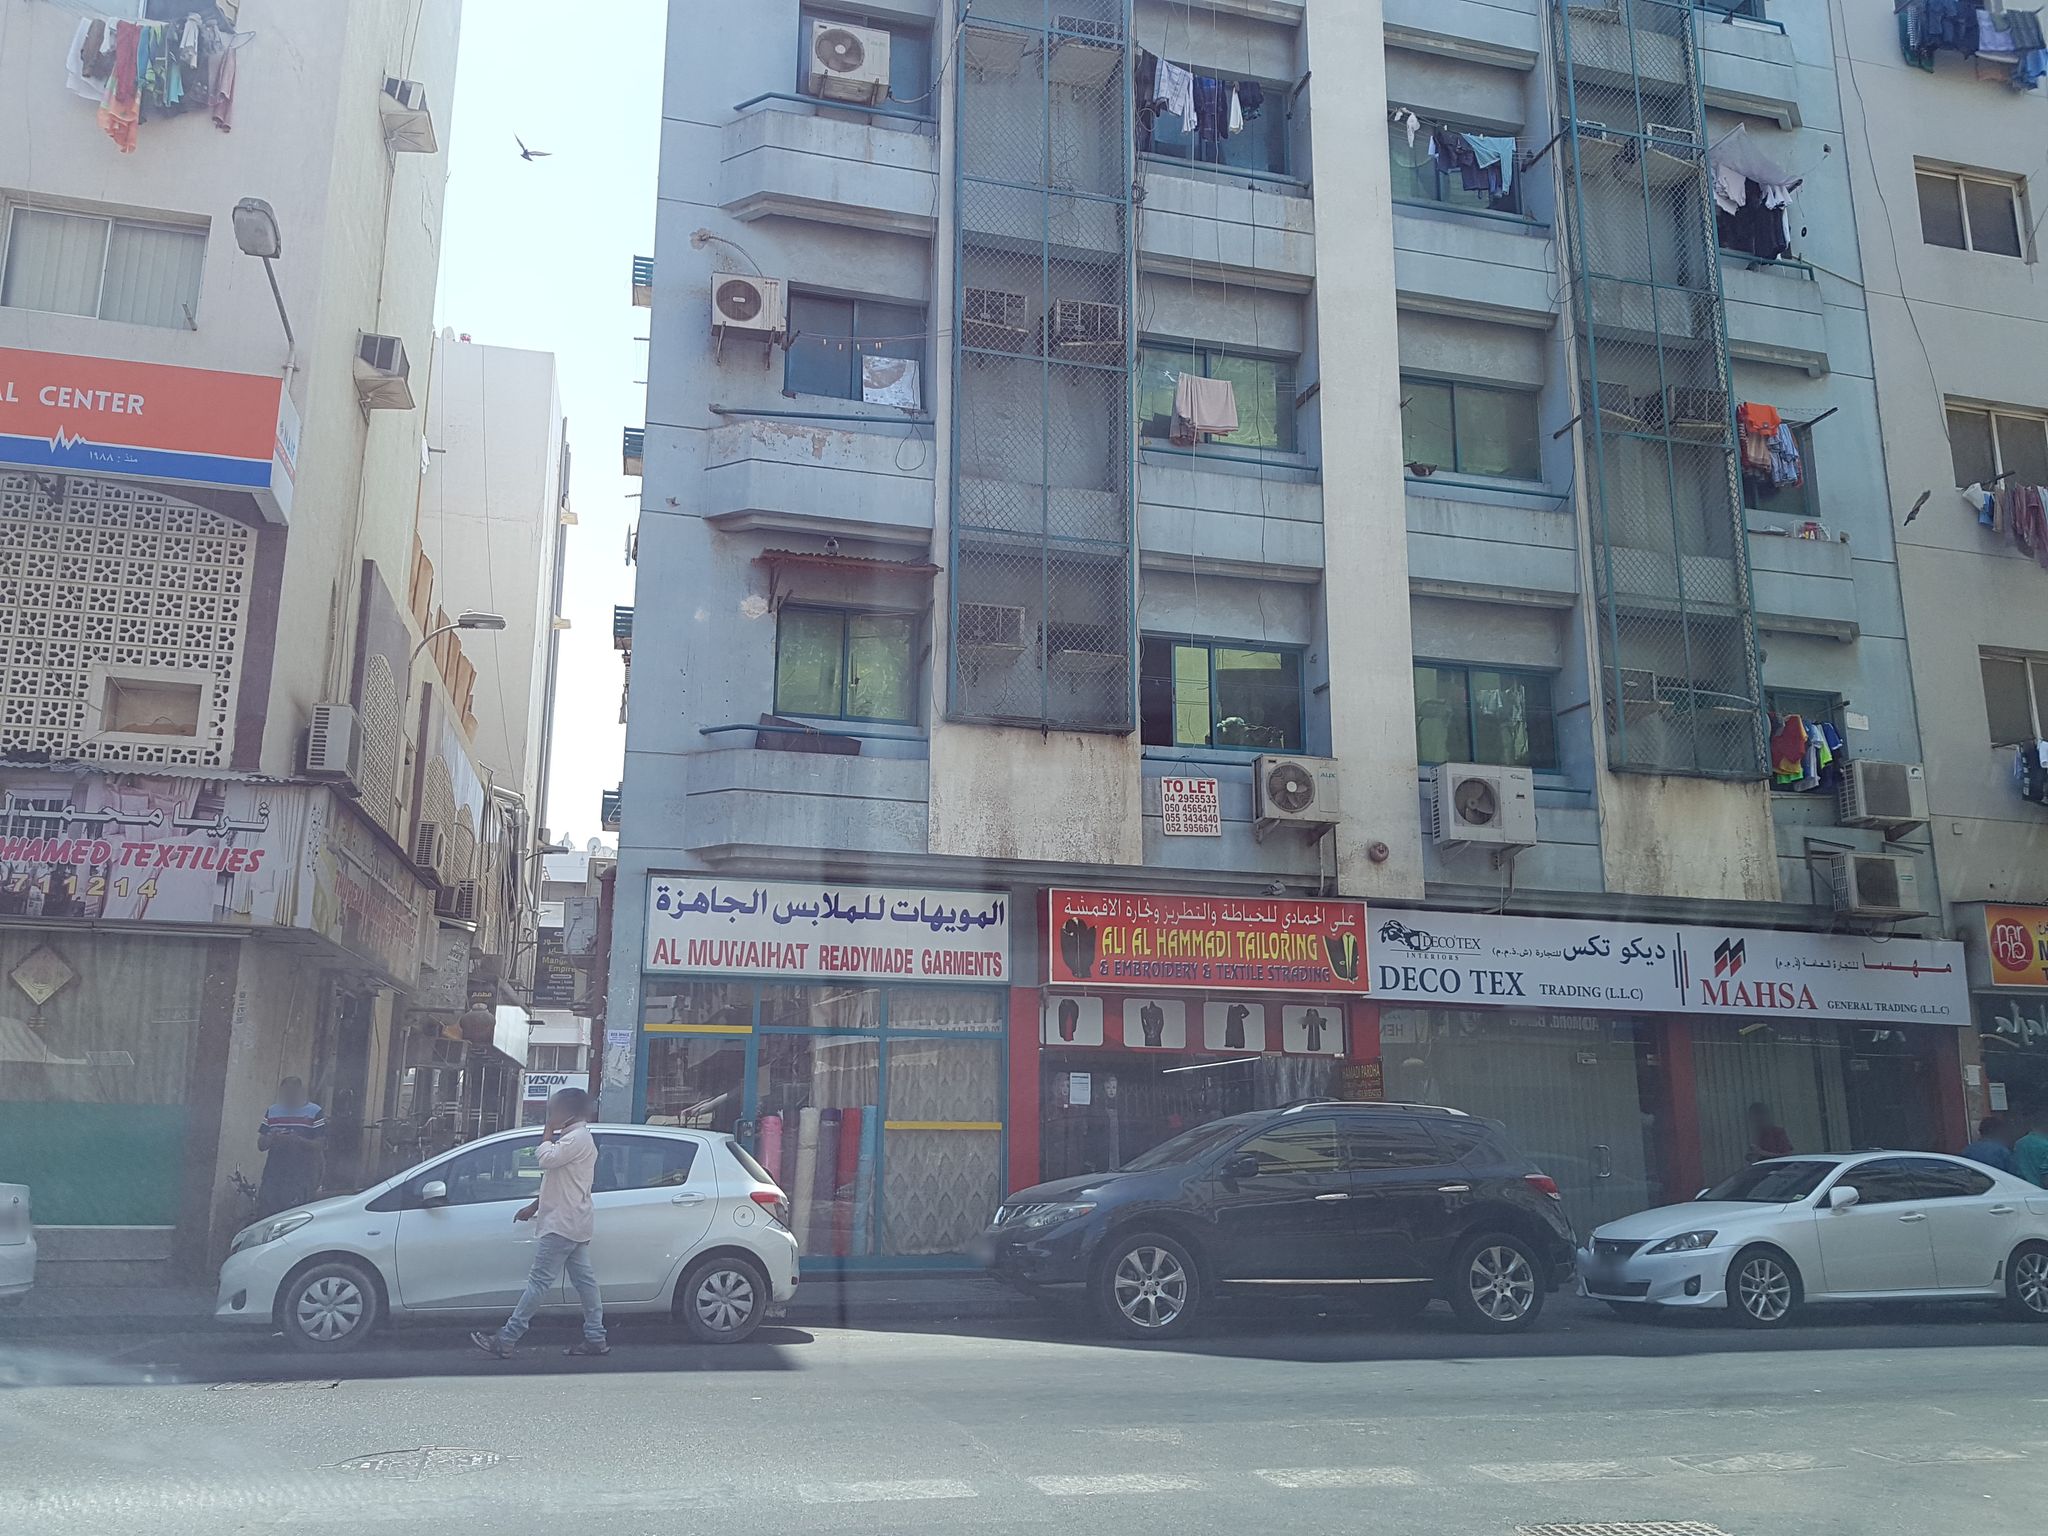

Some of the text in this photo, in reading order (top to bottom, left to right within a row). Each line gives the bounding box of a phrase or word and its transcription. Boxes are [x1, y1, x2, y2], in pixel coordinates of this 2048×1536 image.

[0, 381, 145, 416] L CENTER
[1163, 780, 1216, 794] TO LET
[1164, 793, 1217, 804] 04 2955533
[1164, 803, 1217, 814] 050 4565477
[1165, 813, 1218, 824] 055 3434340
[1165, 822, 1218, 833] 052 5956671
[120, 842, 265, 873] TEXTILIES
[0, 872, 157, 899] 711214
[656, 885, 1005, 933] المويهات للملابس الجاهزة
[1125, 898, 1161, 924] وتجارة
[1163, 901, 1217, 926] والتطريز
[1221, 903, 1278, 927] للخياطة
[1281, 904, 1326, 933] الحمادي
[1330, 908, 1356, 936] علي
[1101, 926, 1319, 962] ALI AL HAMMADI TAILORING
[1406, 952, 1460, 960] INTERIORS
[1535, 948, 1562, 958] للتجارة
[1563, 934, 1610, 961] تكس
[1619, 937, 1666, 966] ديكو
[653, 938, 1003, 978] AL MUWAIHAT READYMADE GARMENTS
[1100, 959, 1109, 977] &
[1114, 960, 1199, 979] EMBROIDERY
[1202, 962, 1212, 979] &
[1216, 963, 1264, 981] TEXTILE
[1379, 965, 1644, 1001] DECO TEX TRADING (L.L.C)
[1700, 979, 1950, 1016] MAHSA GENERAL TRADING (L.L.C)
